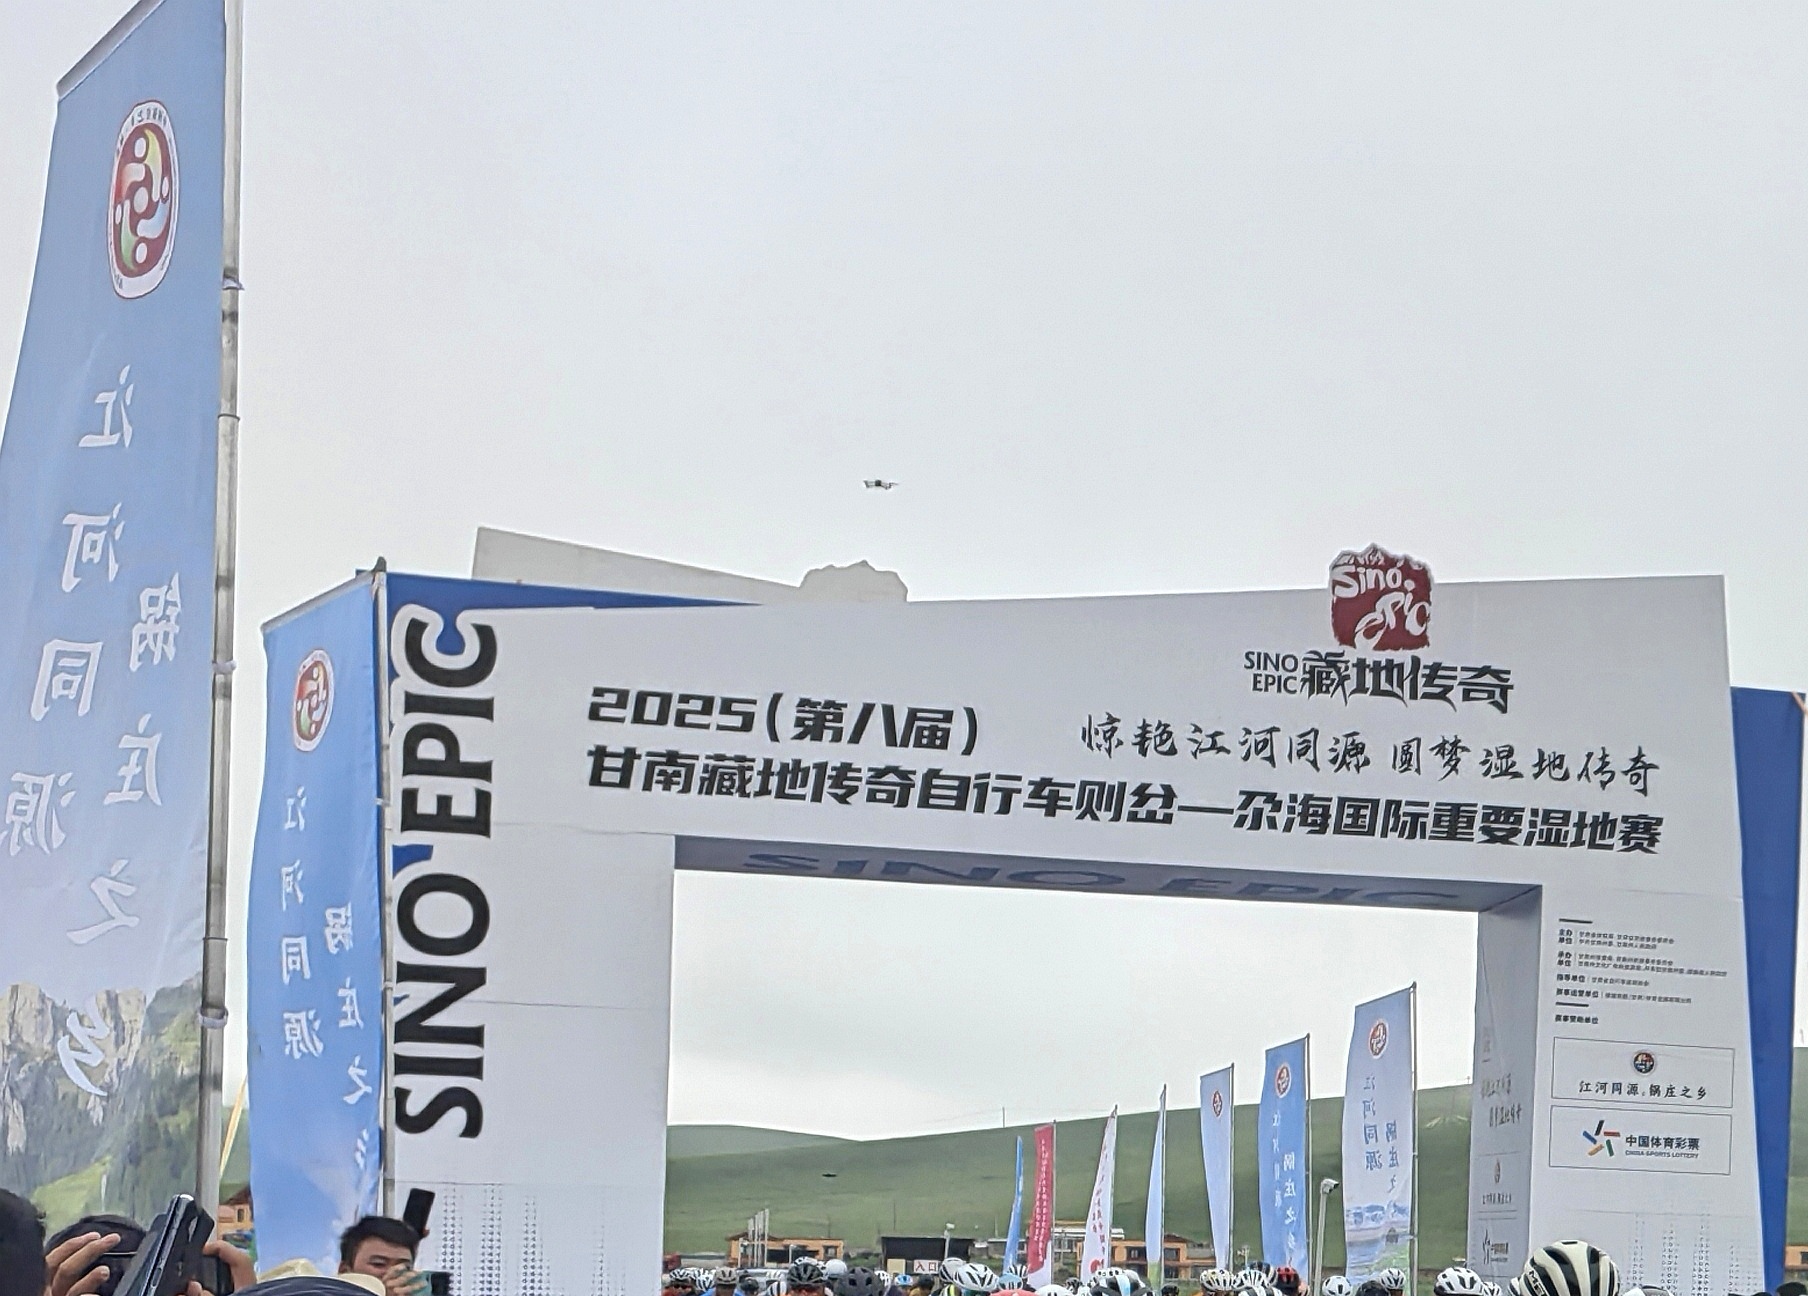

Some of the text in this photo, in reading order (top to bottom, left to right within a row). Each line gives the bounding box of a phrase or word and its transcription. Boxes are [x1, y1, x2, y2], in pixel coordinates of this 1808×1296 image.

[1243, 650, 1299, 674] SINO
[1251, 673, 1298, 696] EPIC
[1300, 650, 1515, 715] 藏地传奇
[393, 617, 498, 1138] SINO EPIC
[1624, 1134, 1701, 1151] 中国体育彩票
